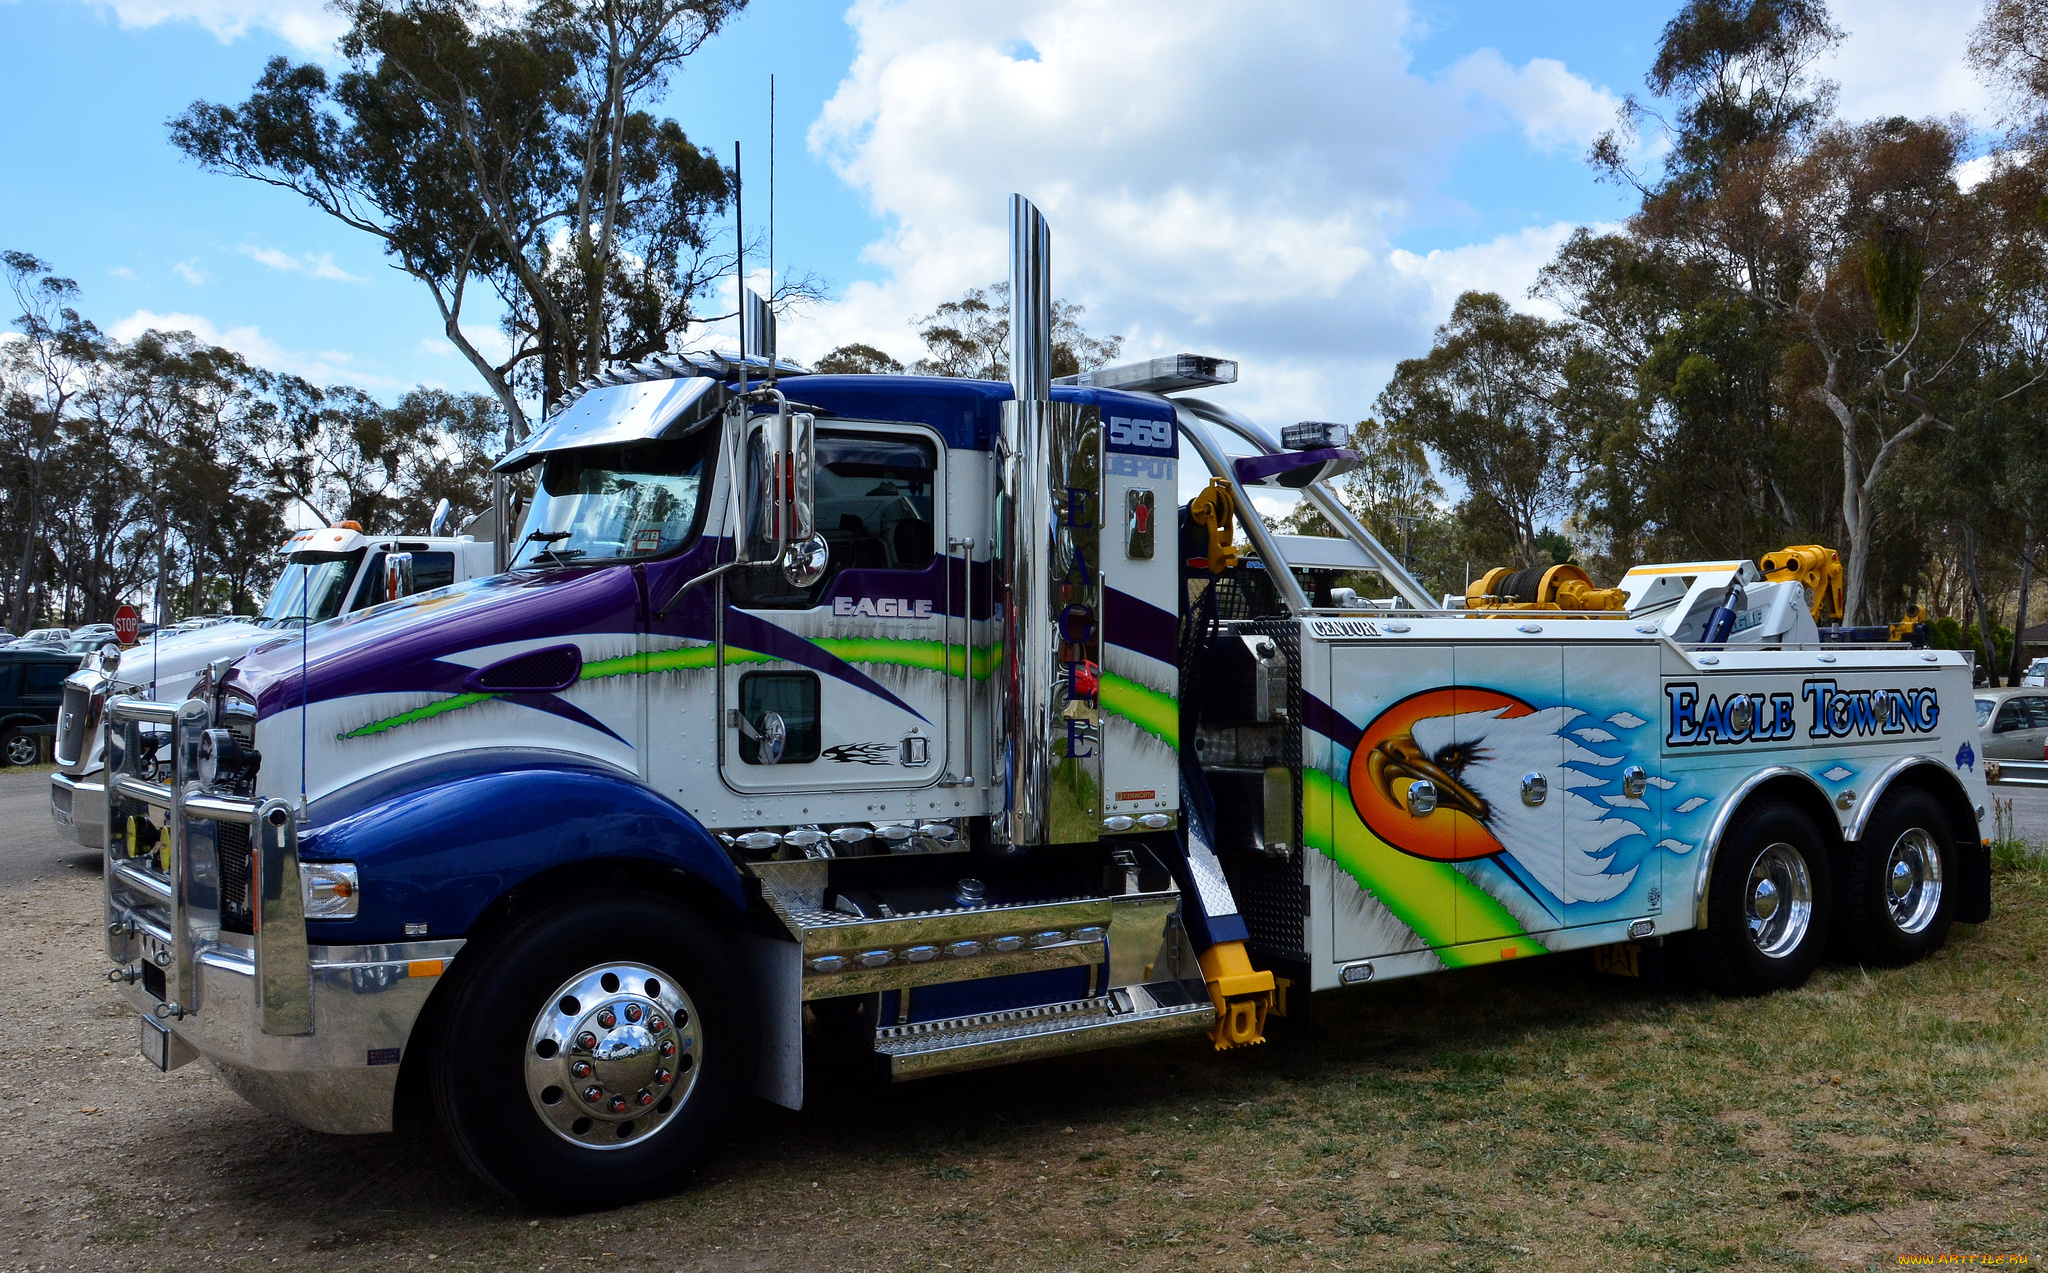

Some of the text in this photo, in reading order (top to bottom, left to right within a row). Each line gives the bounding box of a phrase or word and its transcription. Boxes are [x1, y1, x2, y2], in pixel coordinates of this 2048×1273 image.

[1110, 416, 1172, 449] 569
[1106, 454, 1174, 481] DEPOT
[833, 596, 933, 619] EAGLE
[115, 617, 137, 632] STOP
[1059, 487, 1094, 759] EAGLE
[1311, 621, 1382, 637] CENTURY
[1731, 608, 1763, 634] GLE
[1123, 791, 1155, 800] KENWORTH
[1594, 943, 1641, 978] CAT
